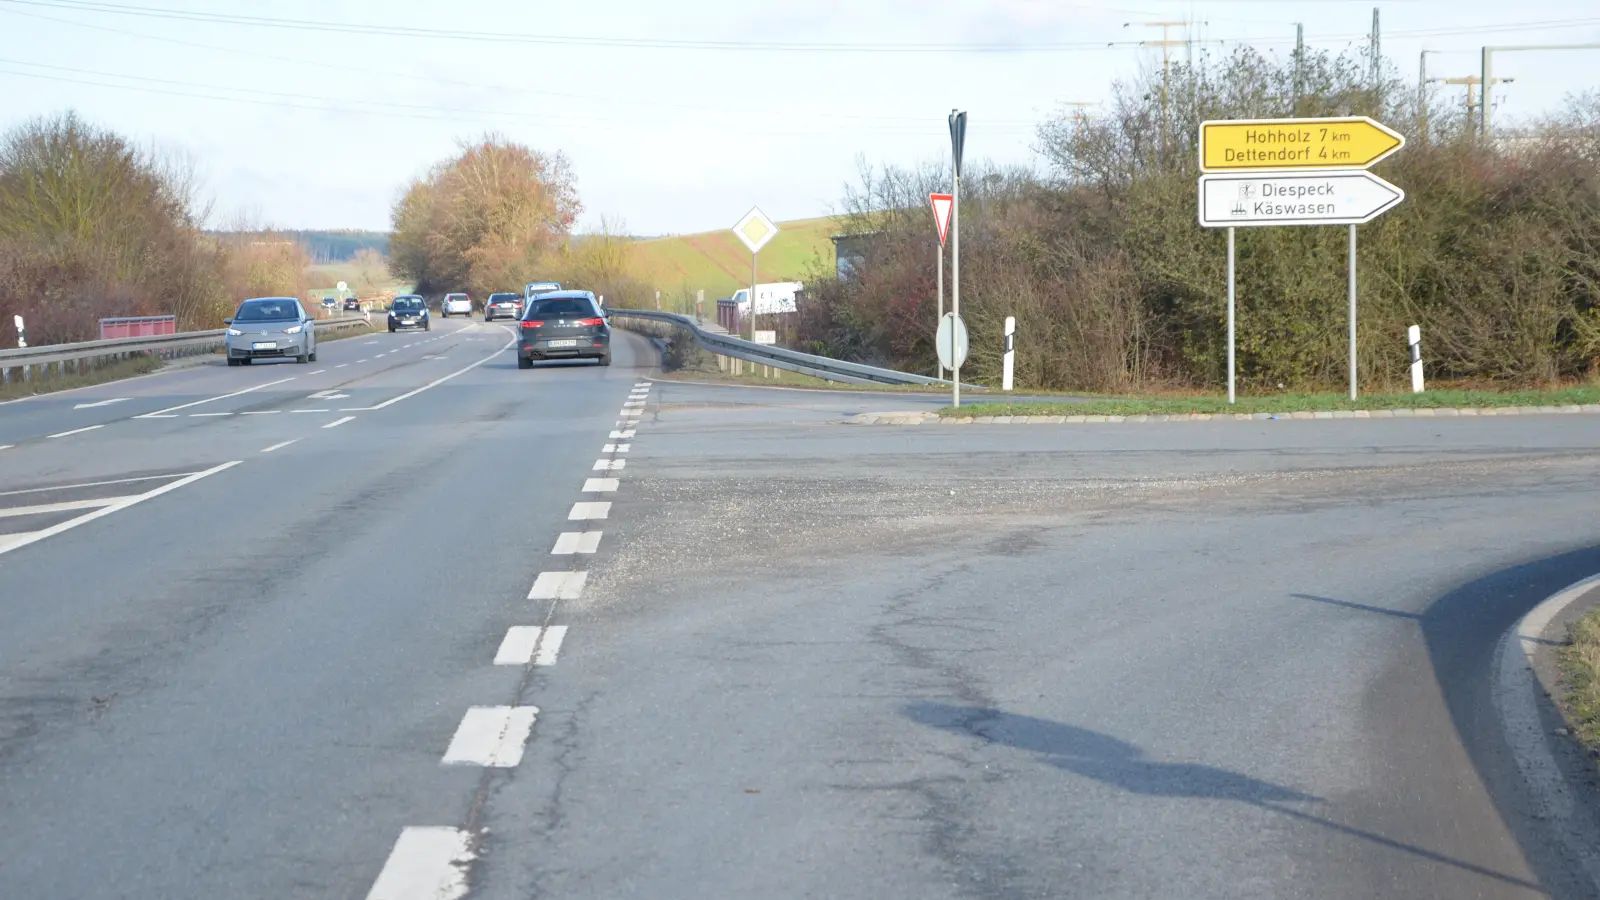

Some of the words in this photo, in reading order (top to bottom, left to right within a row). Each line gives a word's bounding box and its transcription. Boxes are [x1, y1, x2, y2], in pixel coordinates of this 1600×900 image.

[1246, 129, 1310, 144] Hohholz
[1319, 128, 1328, 142] 7
[1332, 131, 1350, 142] km
[1225, 146, 1310, 162] Dettendorf
[1318, 146, 1328, 160] 4
[1332, 149, 1350, 160] km
[1262, 182, 1335, 199] Diespeck
[1254, 201, 1335, 216] Käswasen
